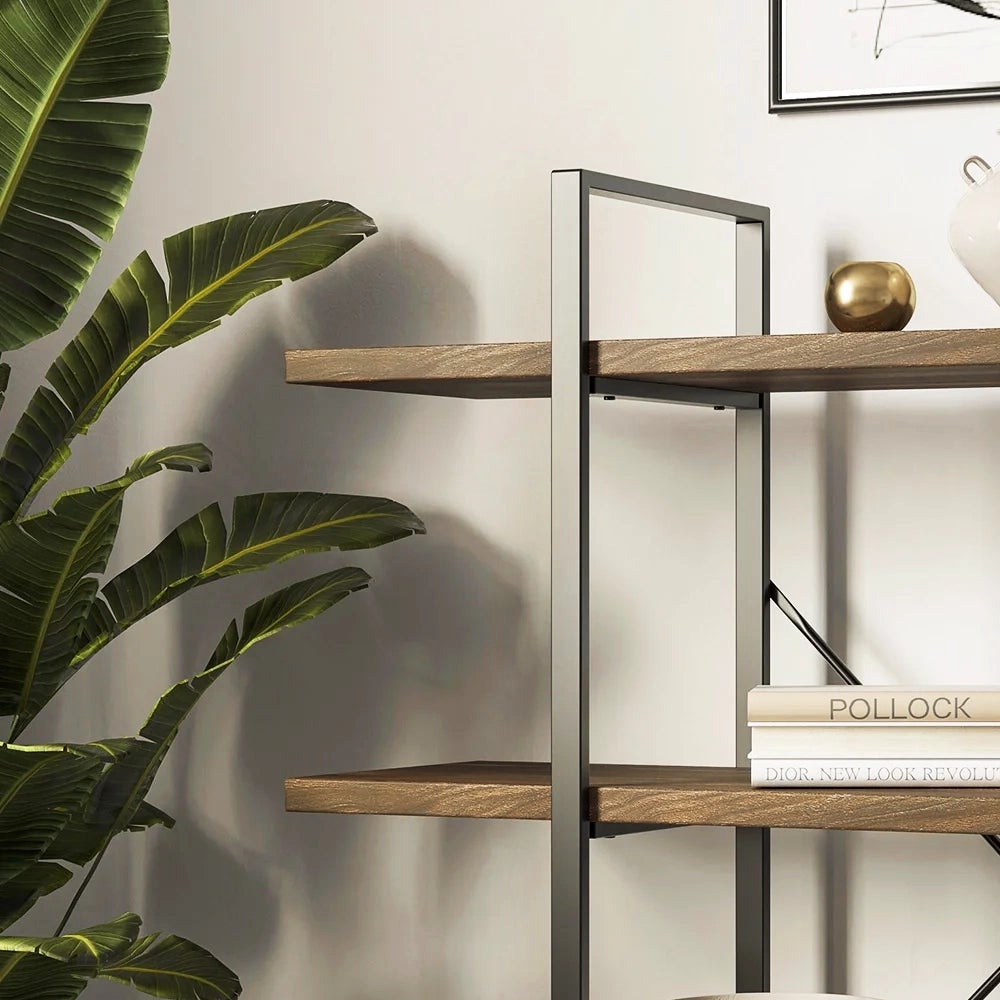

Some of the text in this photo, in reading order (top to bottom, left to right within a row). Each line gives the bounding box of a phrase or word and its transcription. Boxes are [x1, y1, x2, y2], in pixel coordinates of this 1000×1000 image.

[830, 696, 972, 720] POLLOCK
[766, 767, 814, 781] DIOR.
[821, 767, 861, 781] NEW
[867, 767, 917, 781] LOOK
